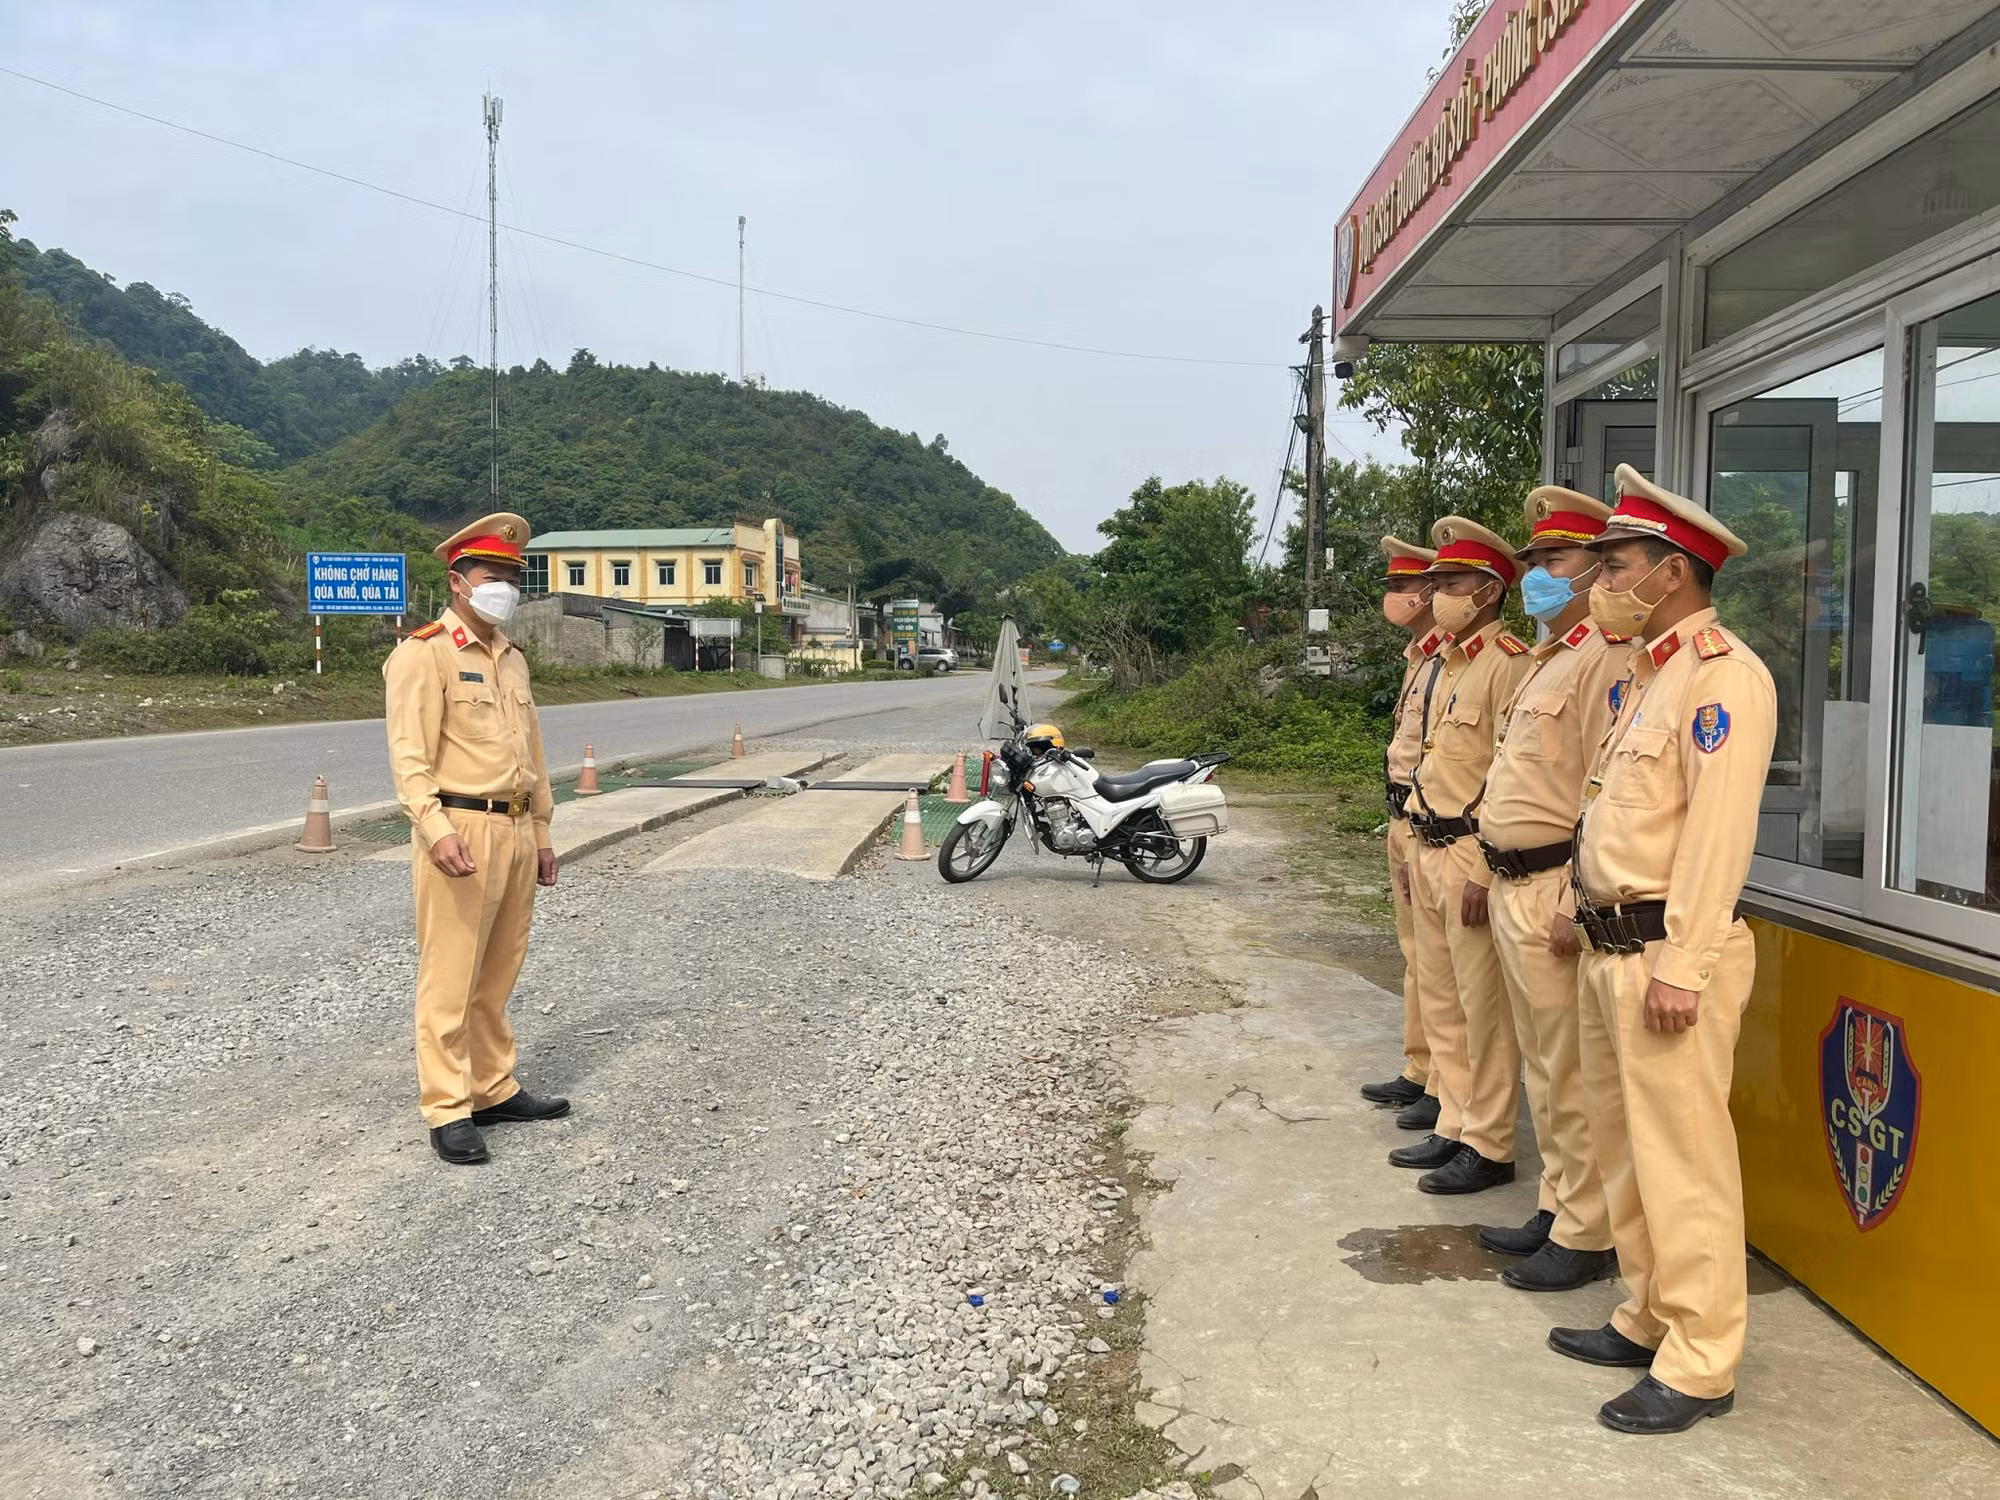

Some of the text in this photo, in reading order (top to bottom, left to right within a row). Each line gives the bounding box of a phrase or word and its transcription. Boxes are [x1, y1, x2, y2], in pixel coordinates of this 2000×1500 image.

[1373, 179, 1397, 253] CSGT
[1482, 0, 1532, 122] PHÒNG
[314, 562, 399, 581] KHÔNG CHỞ HÀNG
[384, 582, 399, 600] TẢI
[1856, 1075, 1878, 1094] CAND
[1832, 1098, 1904, 1159] CSGT
